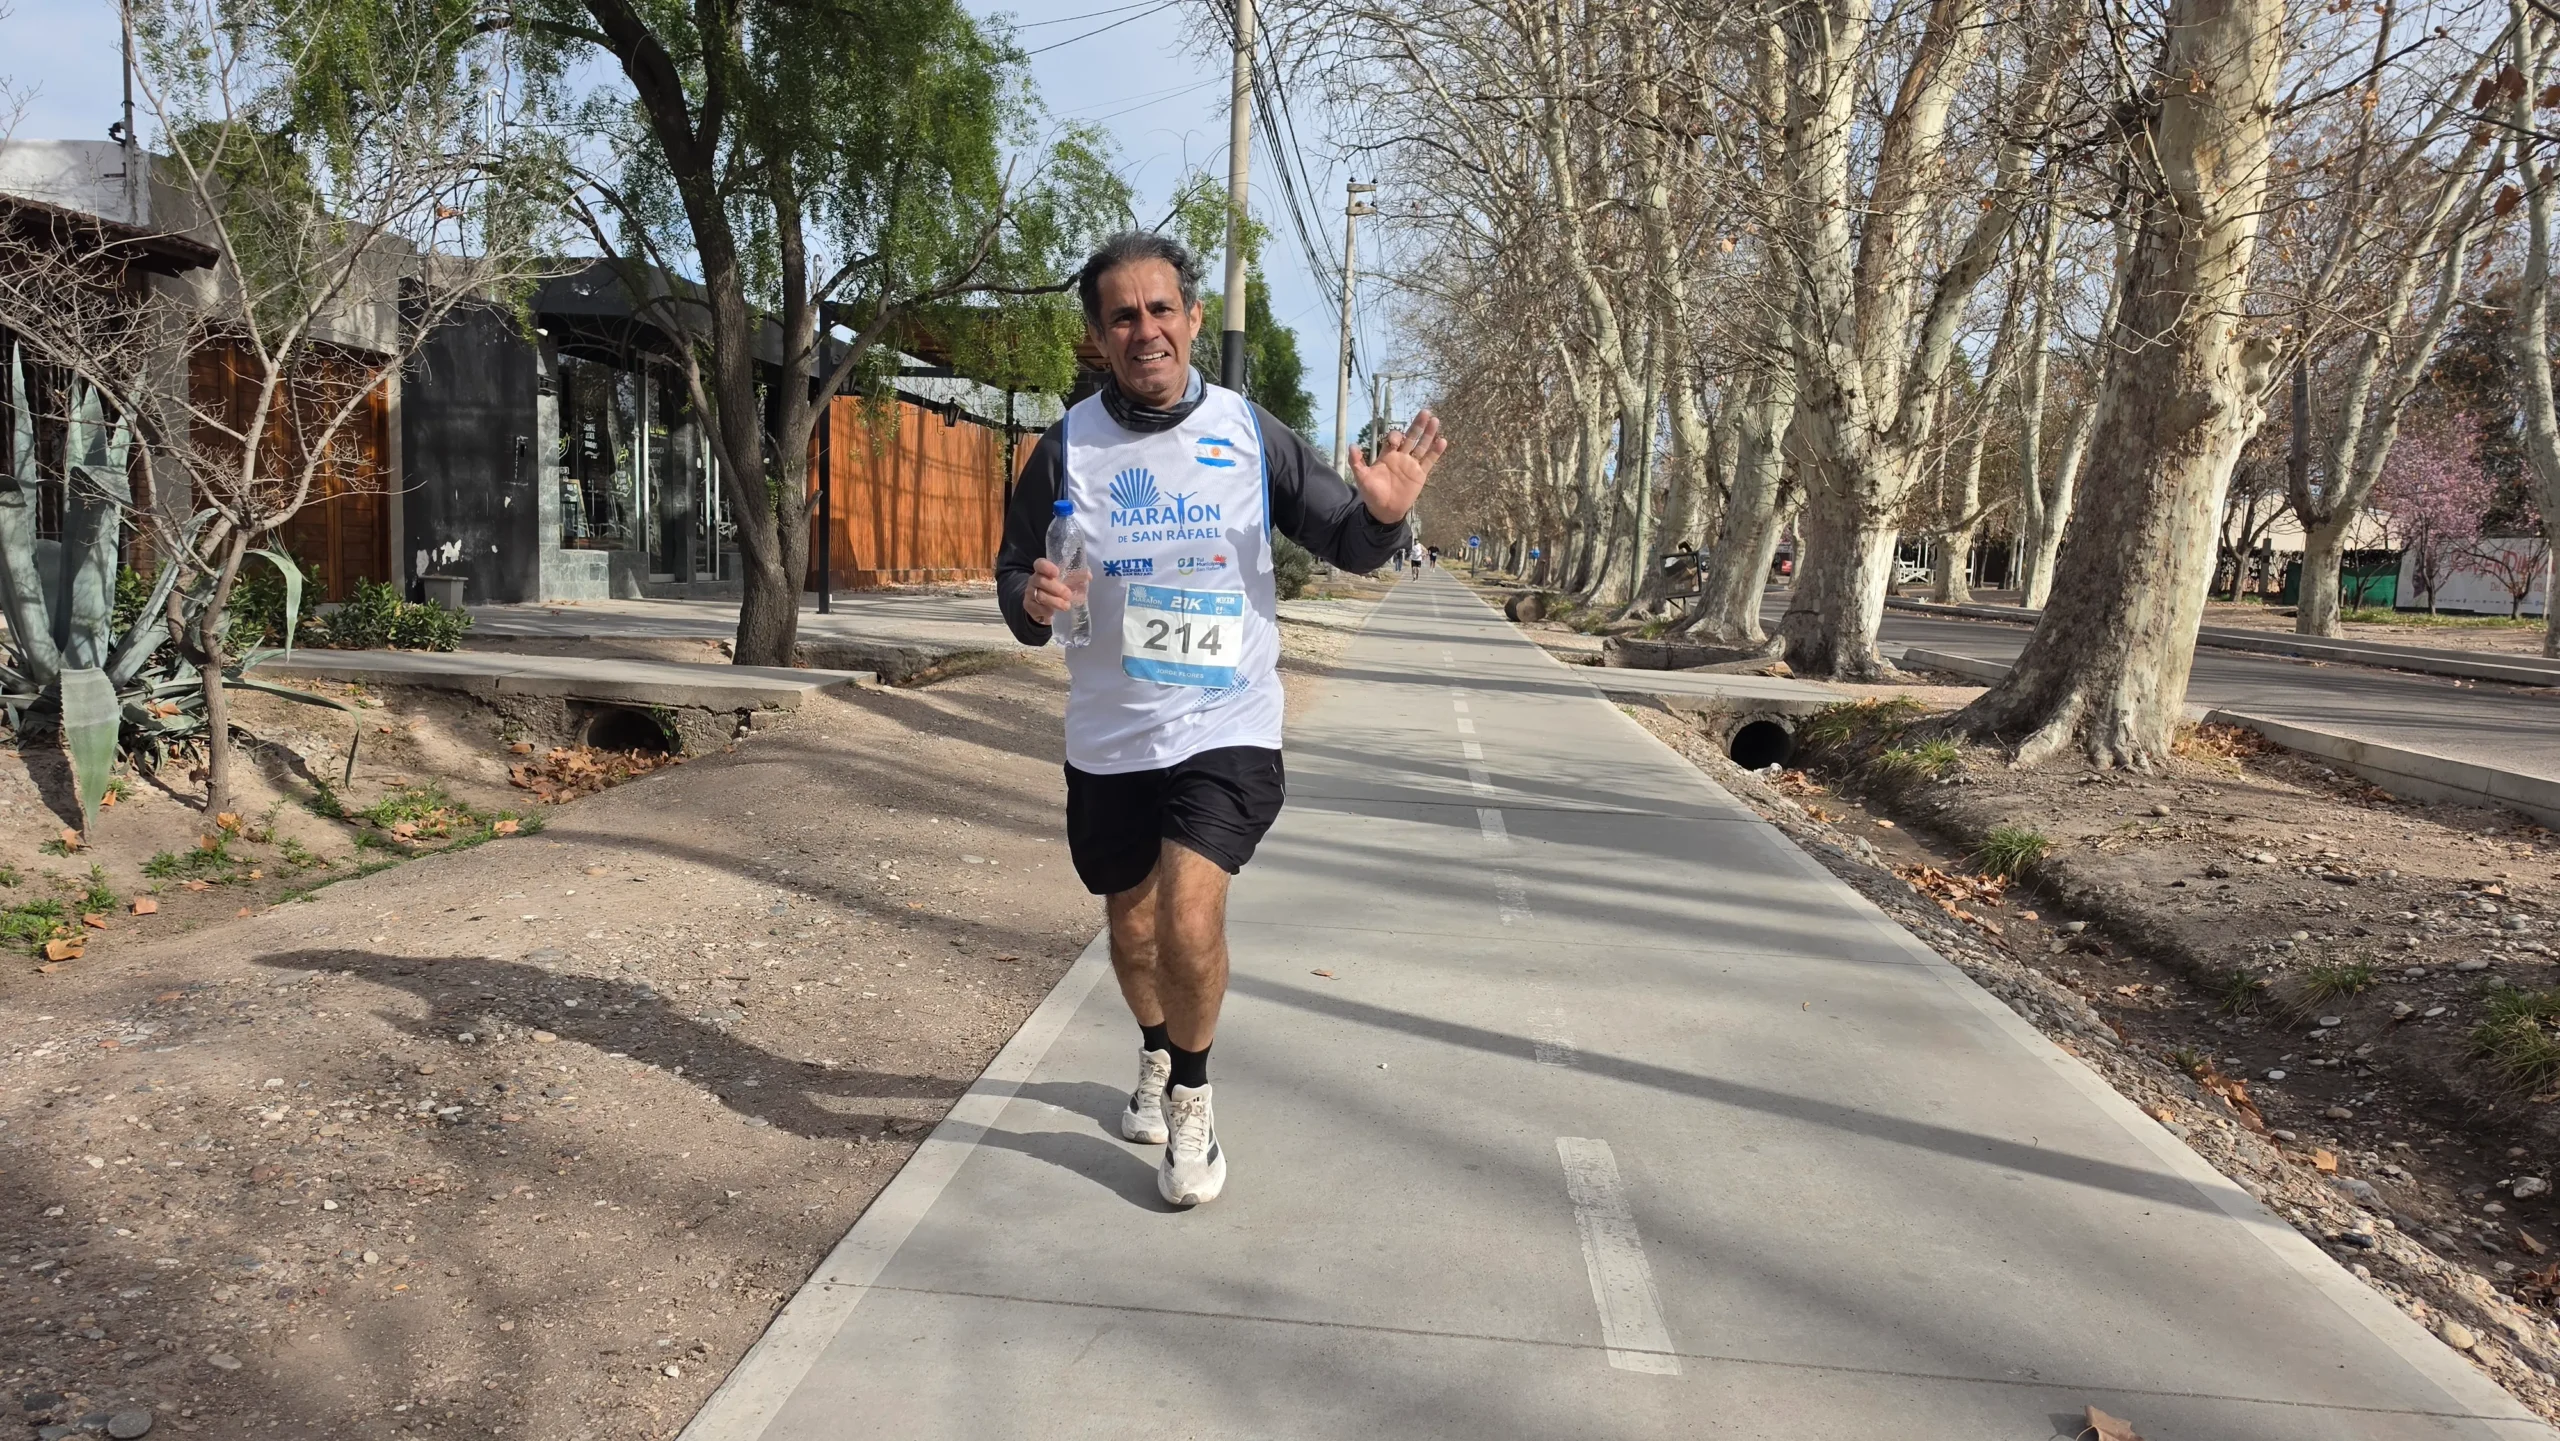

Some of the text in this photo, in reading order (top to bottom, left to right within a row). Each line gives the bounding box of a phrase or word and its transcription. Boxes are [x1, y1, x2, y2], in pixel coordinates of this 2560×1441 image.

[1118, 527, 1221, 543] DE SAN RAFAEL
[1121, 557, 1153, 569] UTN
[1170, 595, 1204, 611] 21K
[1143, 618, 1222, 656] 214
[1156, 668, 1204, 679] JORGE FLORES
